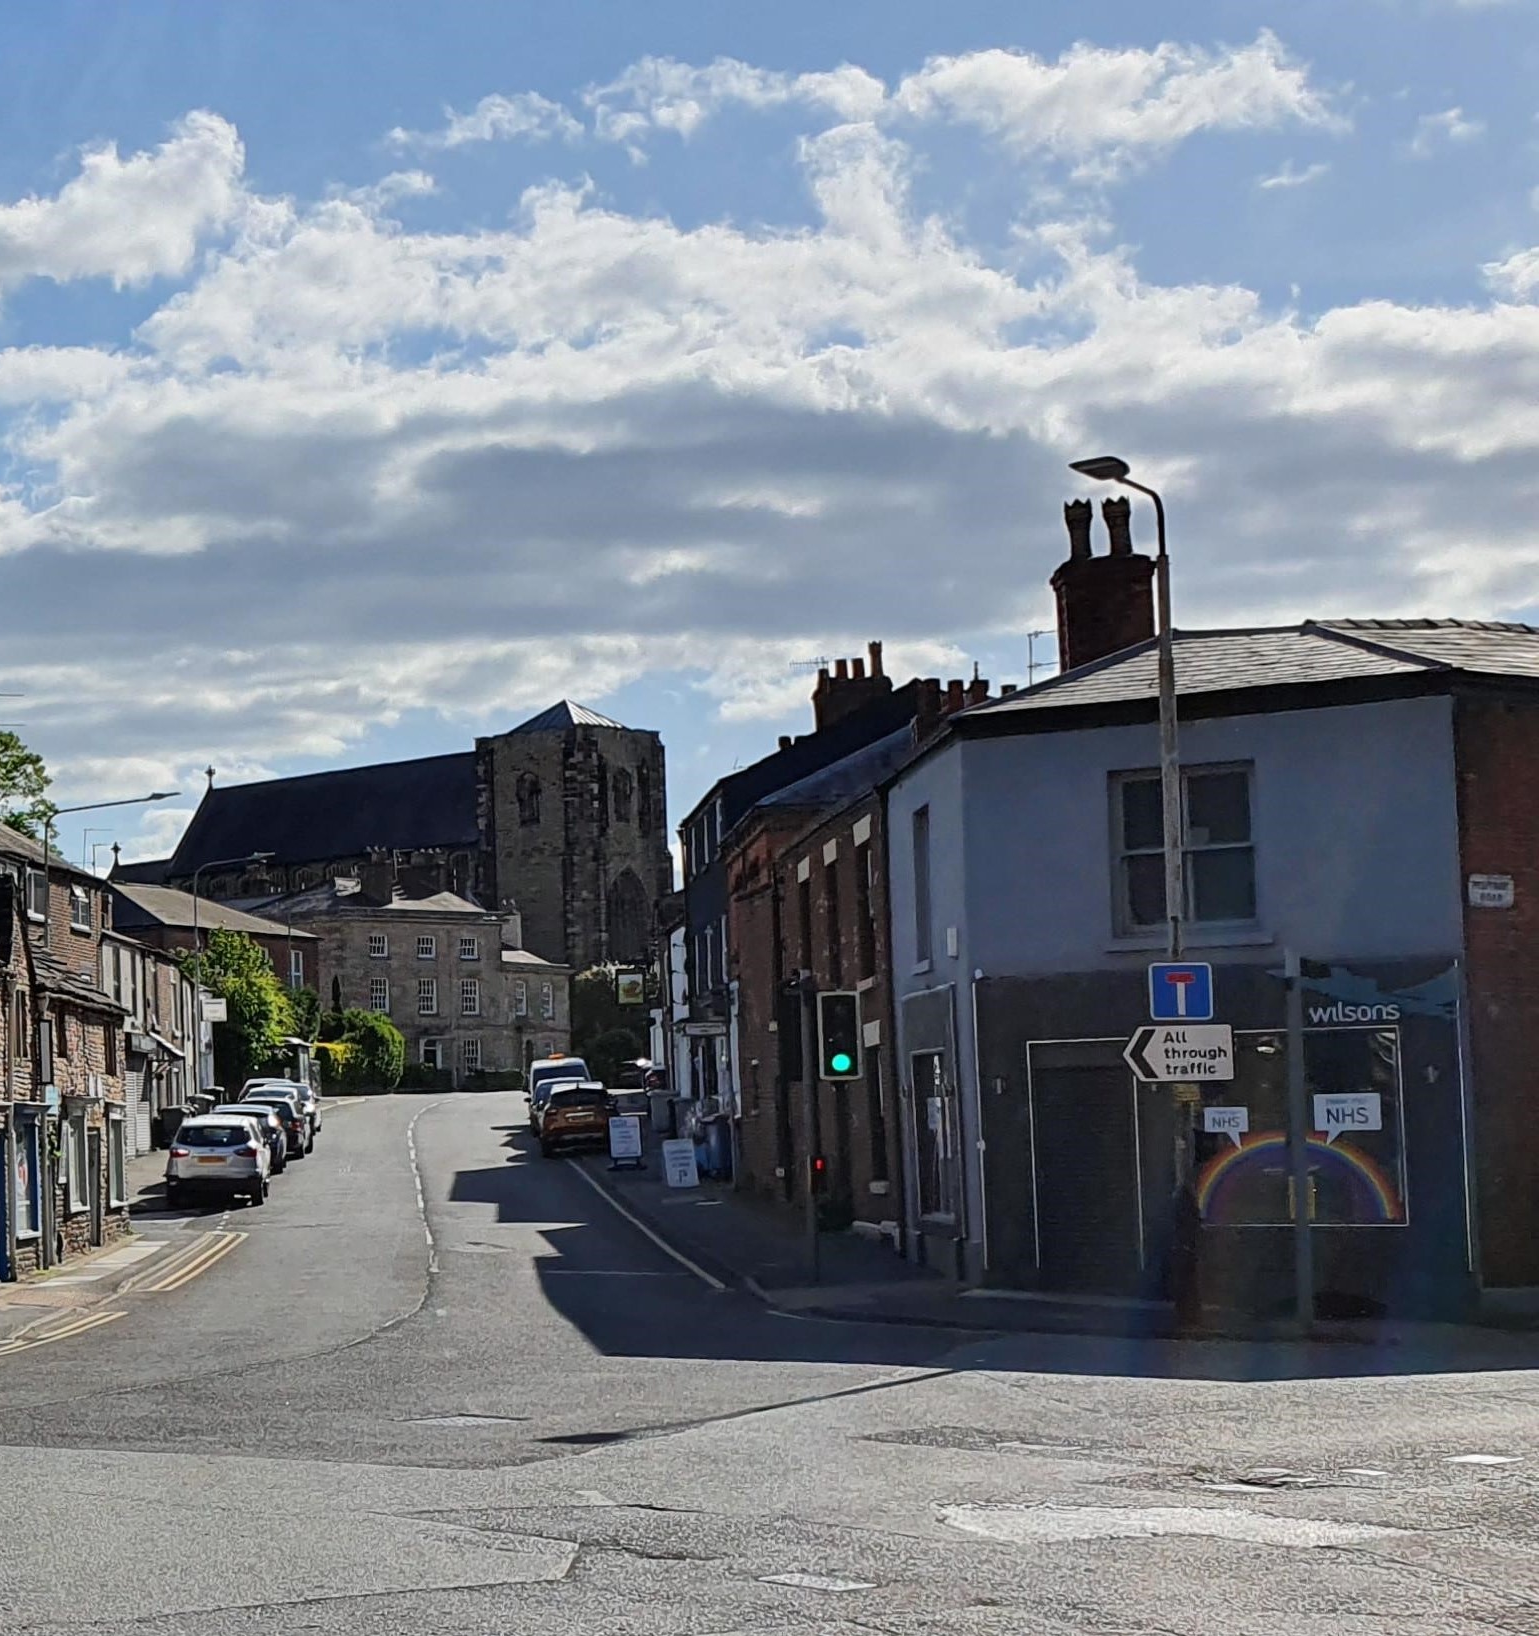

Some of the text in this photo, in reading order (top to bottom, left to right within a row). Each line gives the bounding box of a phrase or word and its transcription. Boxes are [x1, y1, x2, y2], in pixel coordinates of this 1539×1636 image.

[1310, 1001, 1400, 1023] wilsons
[1163, 1031, 1187, 1044] All
[1164, 1046, 1227, 1060] through
[1165, 1063, 1217, 1075] traffic
[1211, 1116, 1241, 1128] NHS
[1325, 1106, 1370, 1125] NHS
